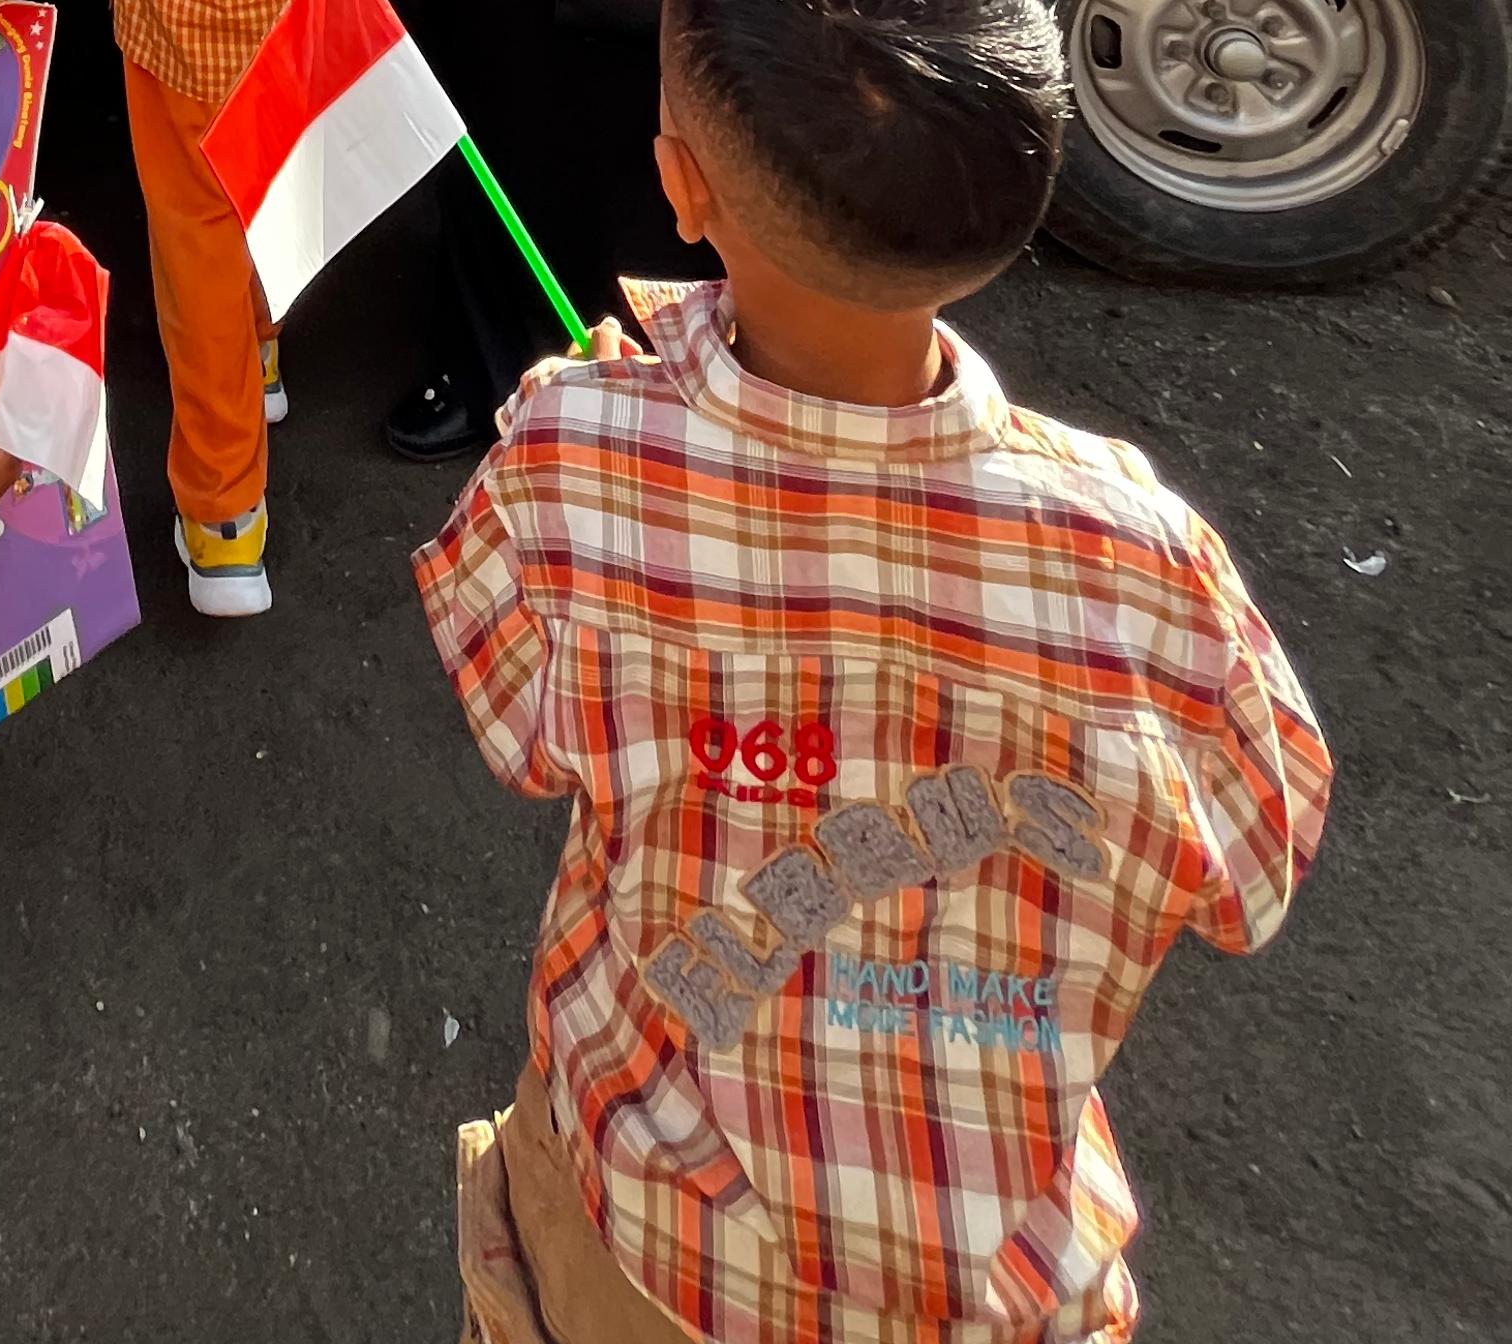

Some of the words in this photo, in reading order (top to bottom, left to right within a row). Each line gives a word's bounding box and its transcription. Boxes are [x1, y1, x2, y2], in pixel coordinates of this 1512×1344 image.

[13, 91, 33, 149] Binatang
[689, 717, 838, 787] 068
[830, 952, 930, 998] HAND
[947, 961, 1056, 1010] MAKE
[929, 1007, 1062, 1053] FASHION
